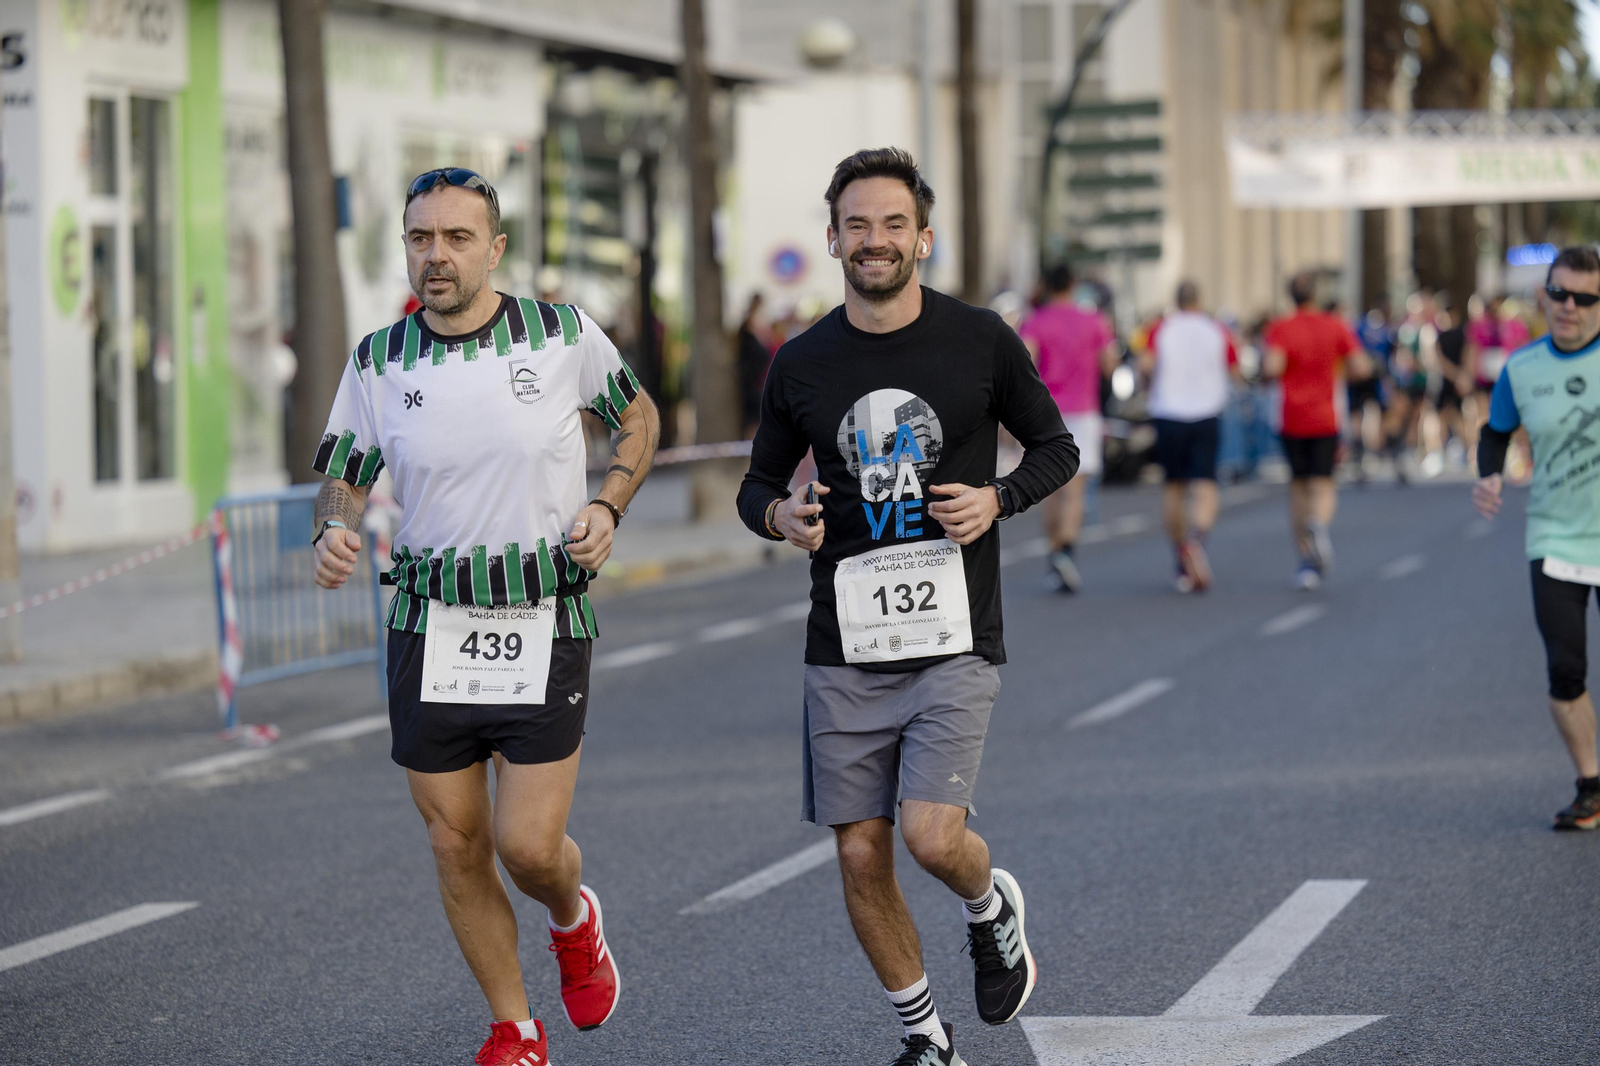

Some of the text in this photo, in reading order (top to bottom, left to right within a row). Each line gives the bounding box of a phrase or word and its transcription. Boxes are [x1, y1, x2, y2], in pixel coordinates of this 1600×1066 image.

[516, 388, 541, 396] NATACIÓN
[856, 423, 925, 465] LA
[861, 462, 924, 503] CA
[861, 499, 924, 540] VE
[862, 546, 958, 567] XXXV MEDIA MARATÓN
[874, 558, 948, 573] BAHÍA DE CÁDIZ
[872, 580, 938, 616] 132
[468, 610, 539, 620] BAHÍA DE CÁDIZ
[459, 630, 523, 662] 439
